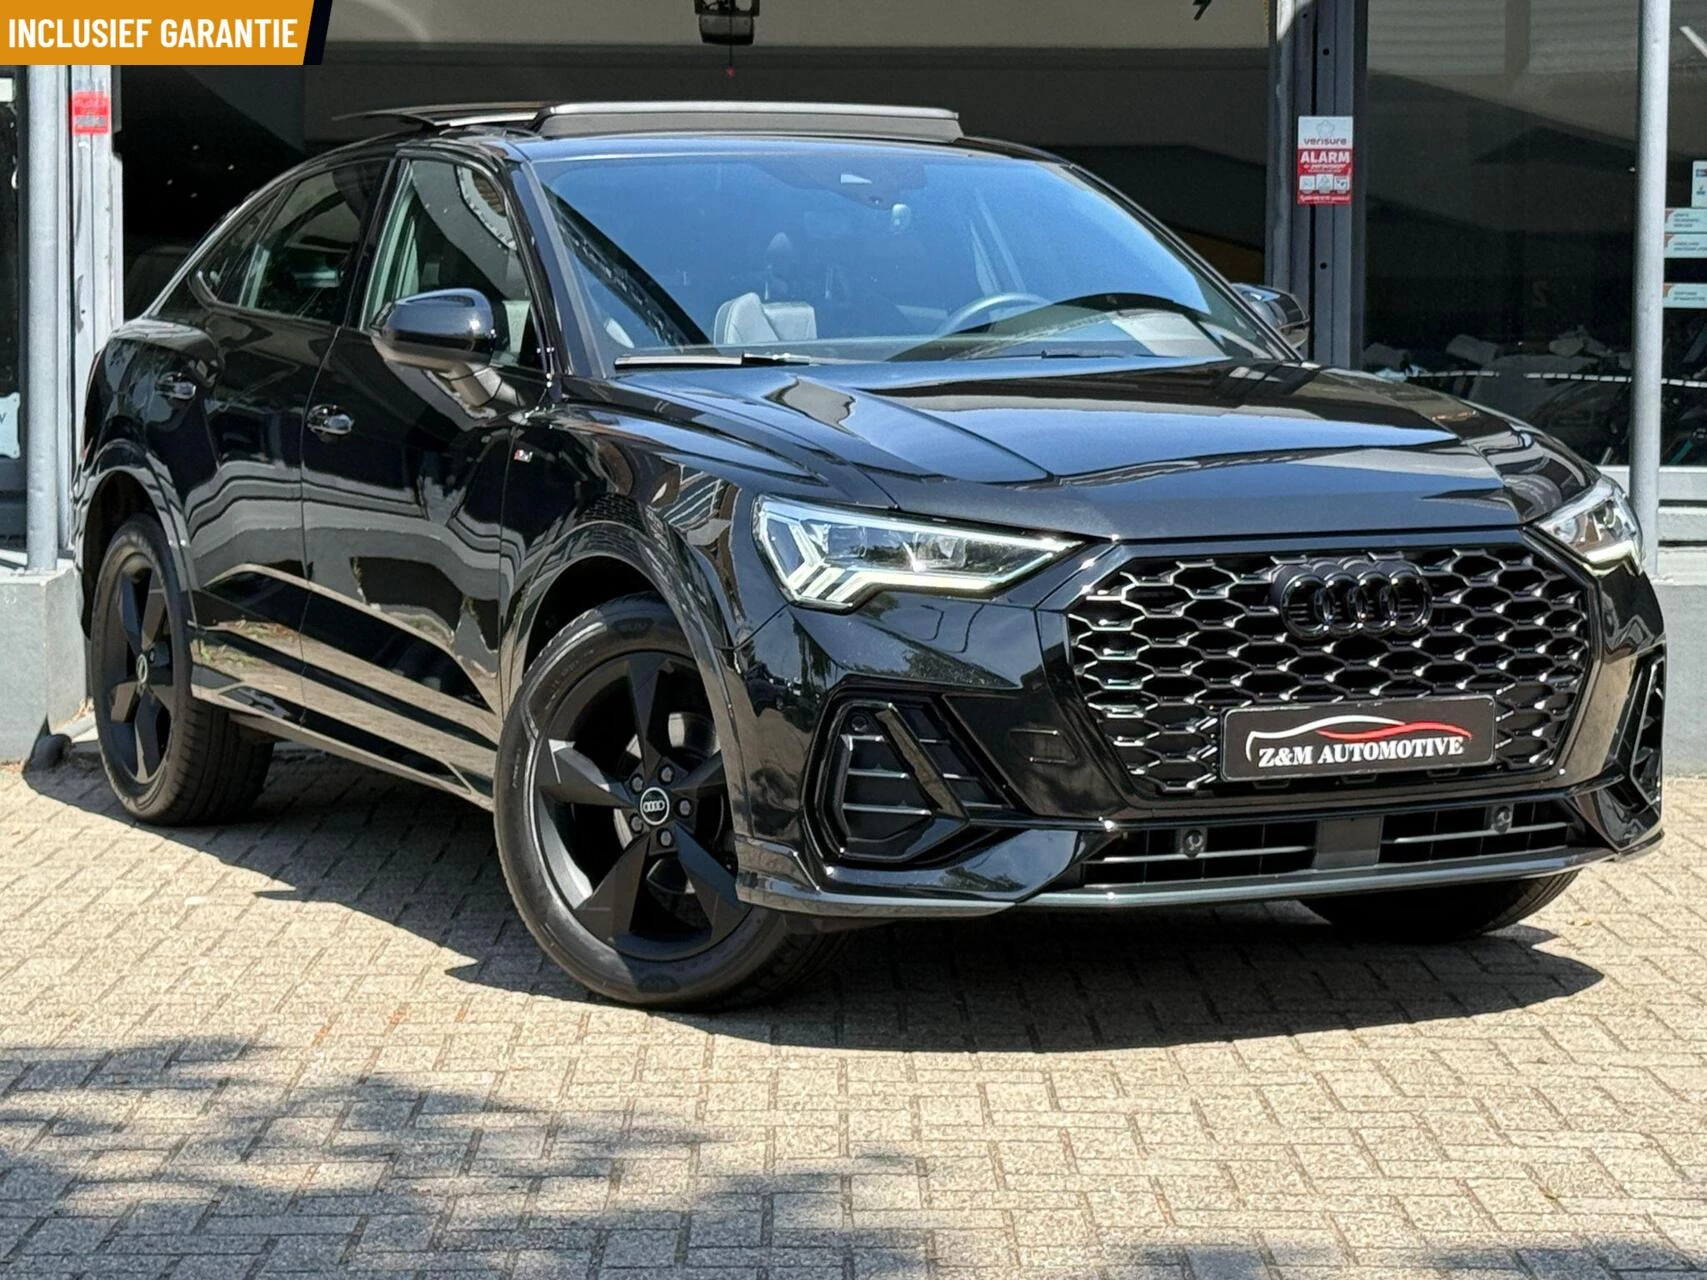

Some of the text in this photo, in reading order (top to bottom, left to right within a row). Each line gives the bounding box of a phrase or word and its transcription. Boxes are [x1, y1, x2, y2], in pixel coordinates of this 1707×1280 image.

[1300, 150, 1350, 164] ALARM
[1258, 735, 1465, 768] Z&M AUTOMOTIVE
